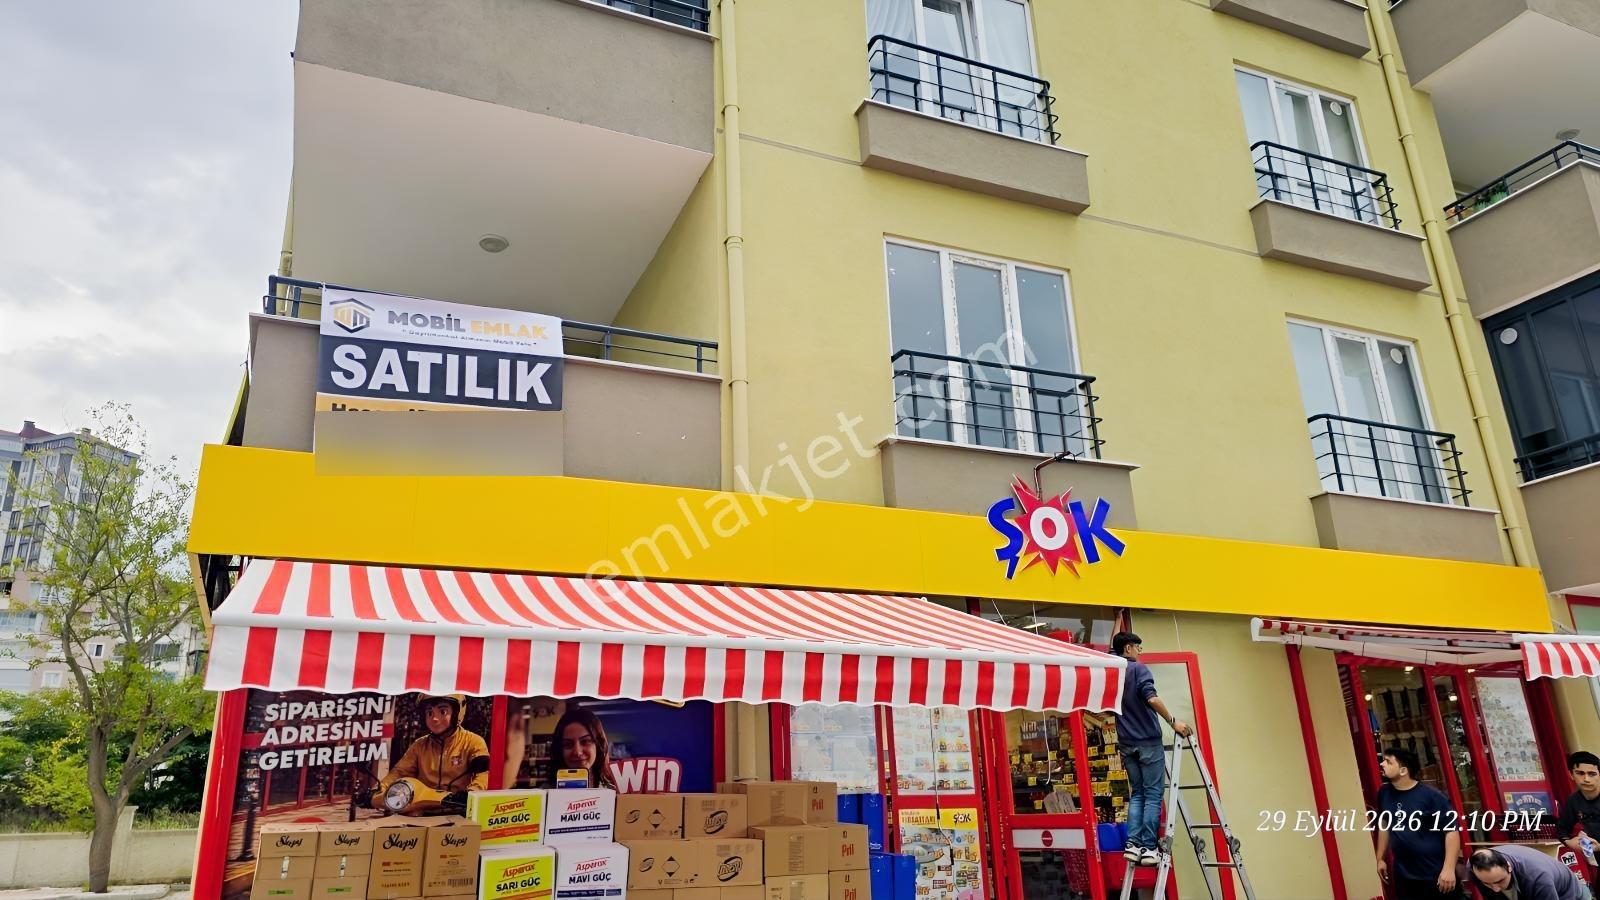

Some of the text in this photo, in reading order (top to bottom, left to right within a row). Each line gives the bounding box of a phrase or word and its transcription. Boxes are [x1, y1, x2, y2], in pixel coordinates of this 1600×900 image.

[388, 310, 549, 340] MOBİL EMLAK
[330, 344, 553, 405] SATILIK
[987, 496, 1126, 580] ŞOK
[487, 813, 531, 826] SARI GÜÇ
[583, 812, 601, 821] GÜÇ
[842, 844, 855, 857] Pril
[592, 871, 612, 882] GÜÇ
[496, 877, 541, 892] SARI GÜÇ
